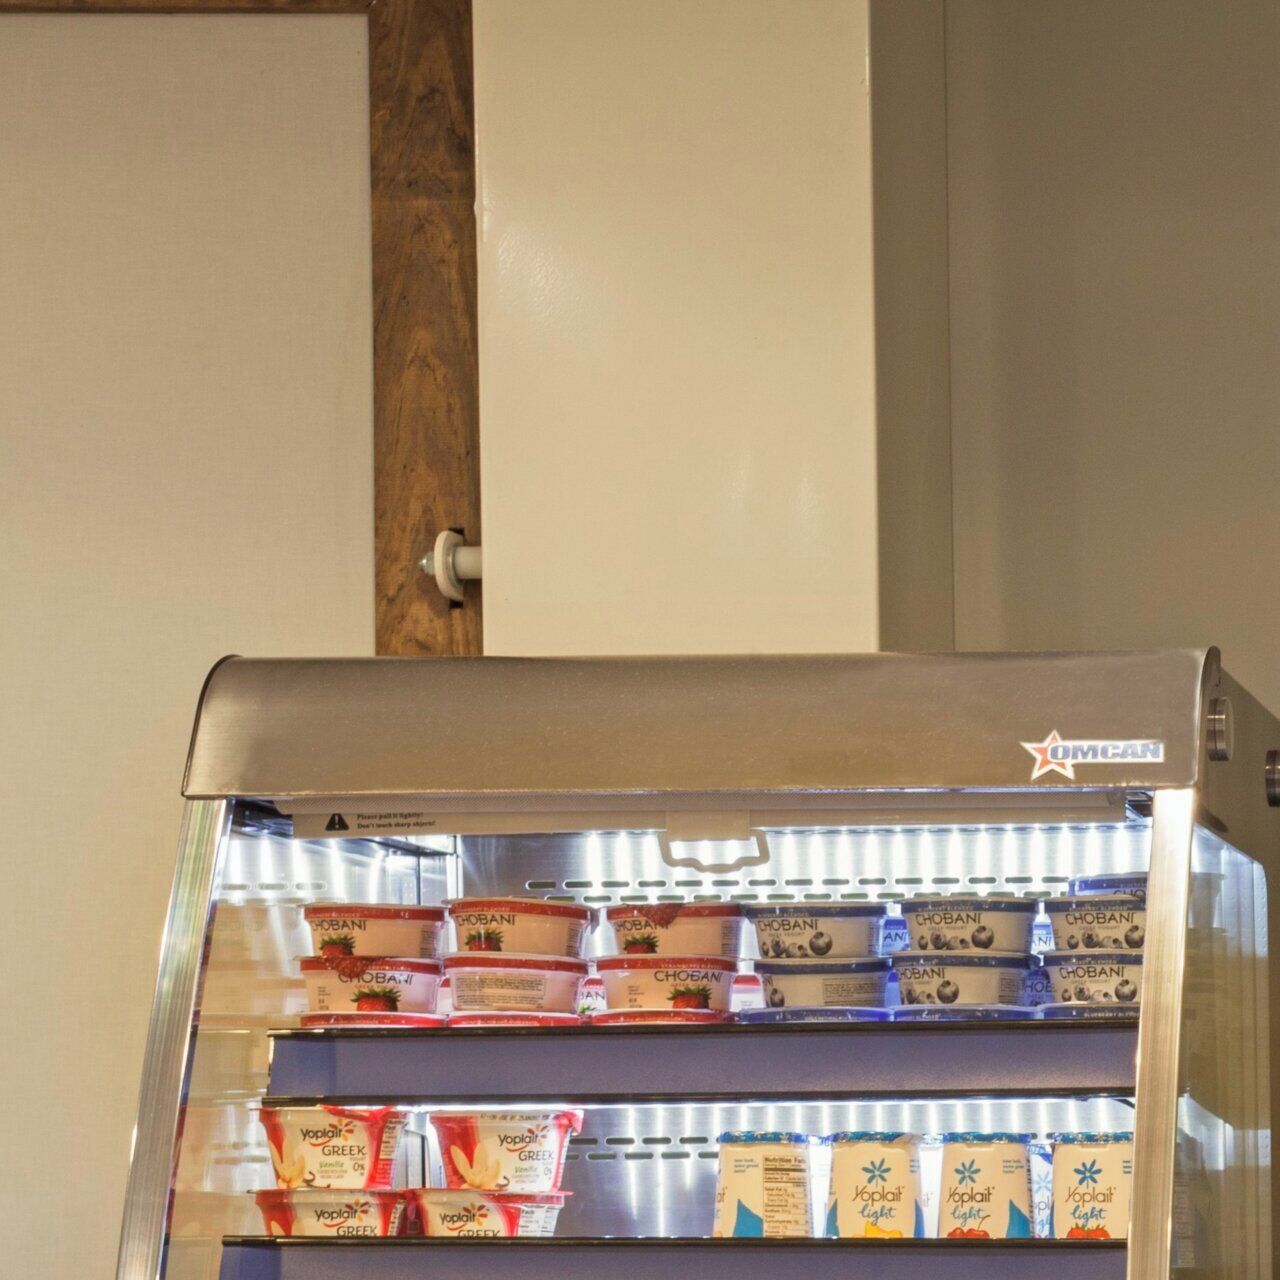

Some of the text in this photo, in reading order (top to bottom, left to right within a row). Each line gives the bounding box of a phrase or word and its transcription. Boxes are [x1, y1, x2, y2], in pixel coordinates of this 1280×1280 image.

[1050, 743, 1161, 760] OMCAN
[758, 918, 819, 932] CHOBANI
[915, 911, 983, 926] CHOBANI
[1065, 912, 1137, 925] CHOBANI
[653, 970, 724, 983] CHOBANI
[1059, 966, 1127, 979] CHOBANI
[300, 1128, 343, 1142] Yoplait
[498, 1134, 539, 1147] Yoplait
[322, 1144, 367, 1157] GREEK
[518, 1150, 555, 1162] GREEK
[852, 1184, 903, 1208] Yoplait
[946, 1186, 993, 1208] Yoplait
[1065, 1186, 1115, 1209] Yoplait
[314, 1208, 358, 1222] Yoplait
[439, 1212, 476, 1226] Yoplait
[859, 1205, 896, 1226] light
[950, 1205, 985, 1227] light
[1070, 1204, 1106, 1227] light
[336, 1225, 378, 1236] GREEK
